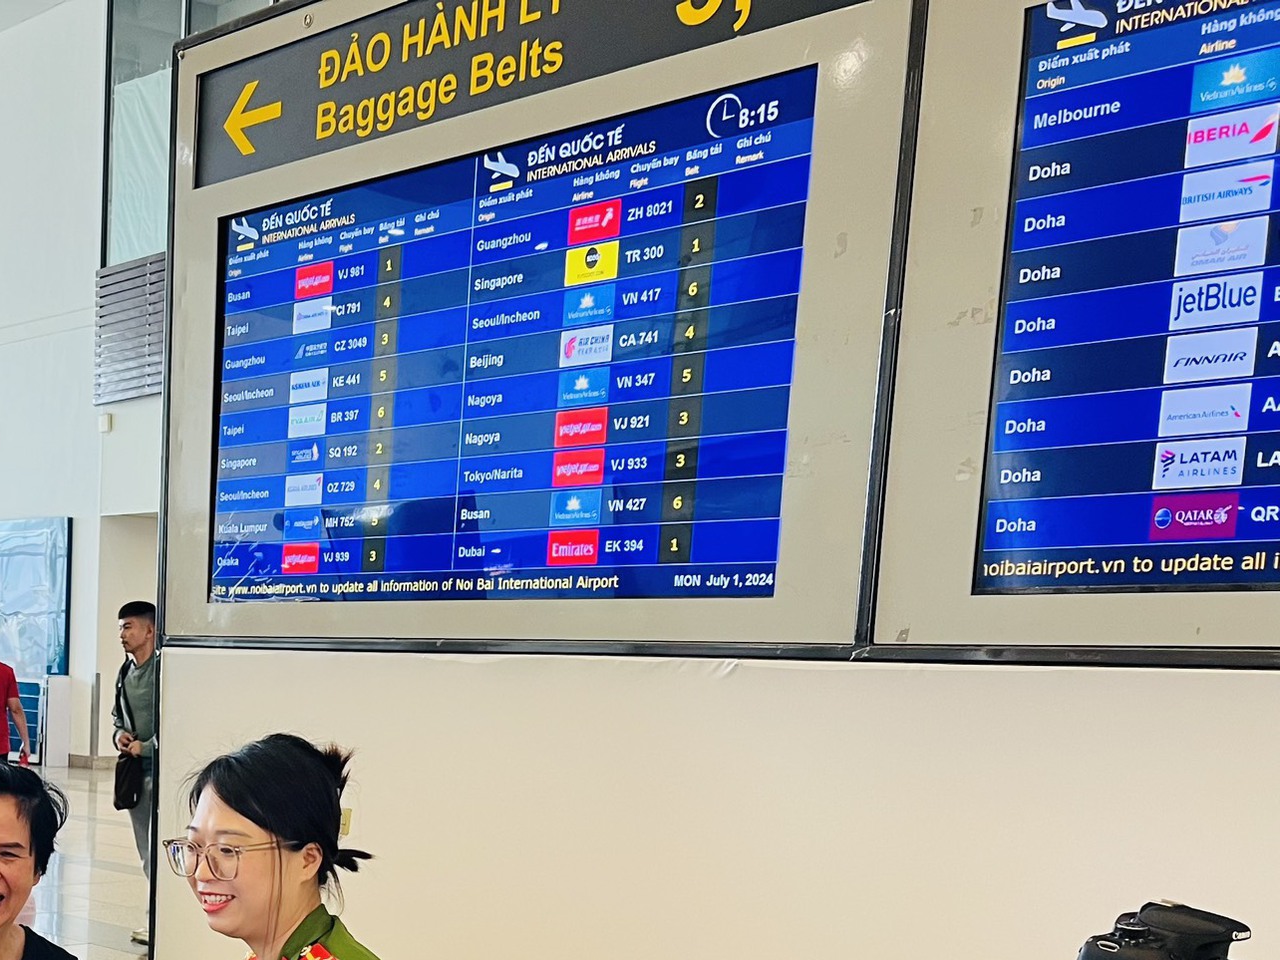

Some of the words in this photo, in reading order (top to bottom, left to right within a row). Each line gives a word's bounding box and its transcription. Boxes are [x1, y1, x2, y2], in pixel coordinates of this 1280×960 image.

[318, 33, 391, 89] ĐẢO
[402, 0, 507, 63] HÀNH
[315, 73, 458, 140] Baggage
[469, 38, 564, 96] Belts
[738, 101, 779, 129] 8:15
[1033, 100, 1120, 130] Melbourne
[527, 142, 555, 167] ĐẾN
[560, 133, 601, 159] QUỐC
[602, 123, 625, 148] TẾ
[527, 156, 604, 182] INTERNATIONAL
[604, 141, 656, 165] ARRIVALS
[1028, 160, 1071, 181] Doha
[1188, 121, 1250, 145] IBERIA
[477, 231, 531, 251] Guangzhou
[627, 207, 643, 221] ZH
[646, 201, 673, 218] 8021
[695, 194, 704, 208] 2
[1024, 212, 1066, 232] Doha
[1182, 192, 1216, 205] BRITISH
[1217, 186, 1253, 199] AIRWAYS
[228, 290, 250, 302] Busan
[338, 268, 349, 280] VJ
[351, 265, 364, 276] 981
[385, 258, 393, 271] 1
[474, 272, 523, 291] Singapore
[625, 249, 641, 263] TR
[643, 245, 664, 260] 300
[691, 238, 700, 253] 1
[1019, 265, 1061, 284] Doha
[472, 309, 540, 330] Seoul/Incheon
[622, 291, 638, 305] VN
[640, 287, 661, 302] 417
[688, 282, 698, 295] 6
[1014, 317, 1056, 334] Doha
[1174, 282, 1257, 321] jetBlue
[225, 354, 266, 371] Guangzhou
[334, 340, 346, 352] CZ
[348, 337, 367, 349] 3049
[382, 333, 389, 345] 3
[470, 353, 503, 370] Beijing
[619, 334, 637, 347] CA
[640, 330, 658, 344] 741
[685, 326, 695, 338] 4
[1009, 367, 1051, 385] Doha
[1173, 351, 1247, 367] FINNAIR
[223, 387, 274, 403] Seoul/Incheon
[333, 376, 344, 387] KE
[346, 374, 361, 385] 441
[380, 370, 387, 381] 5
[468, 392, 503, 408] Nagoya
[617, 375, 633, 388] VN
[635, 373, 655, 387] 347
[682, 368, 692, 382] 5
[465, 431, 501, 446] Nagoya
[614, 417, 627, 430] VJ
[629, 415, 650, 428] 921
[679, 412, 689, 425] 3
[1005, 419, 1046, 434] Doha
[464, 467, 523, 483] Tokyo/Narita
[611, 459, 625, 470] VJ
[627, 457, 647, 469] 933
[675, 454, 685, 467] 3
[1000, 468, 1041, 484] Doha
[1180, 449, 1238, 464] LATAM
[1178, 466, 1238, 478] AIRLINES
[461, 509, 490, 520] Busan
[608, 500, 623, 512] VN
[625, 498, 646, 511] 427
[673, 497, 682, 509] 6
[995, 518, 1036, 533] Doha
[1175, 508, 1213, 525] QATAR
[458, 545, 485, 558] Dubai
[552, 543, 594, 557] Emirates
[605, 541, 621, 552] EK
[624, 539, 644, 551] 394
[670, 538, 678, 551] 1
[1133, 556, 1153, 573] to
[1160, 553, 1234, 574] update
[1241, 552, 1266, 570] all
[320, 583, 329, 593] to
[331, 581, 364, 596] update
[367, 580, 377, 592] all
[380, 579, 439, 592] information
[441, 578, 453, 591] of
[456, 577, 473, 590] Noi
[477, 576, 494, 590] Bai
[497, 574, 572, 590] International
[576, 575, 619, 592] Airport
[674, 574, 701, 587] MON
[706, 573, 730, 589] July
[733, 574, 743, 589] 1,
[745, 572, 774, 586] 2024
